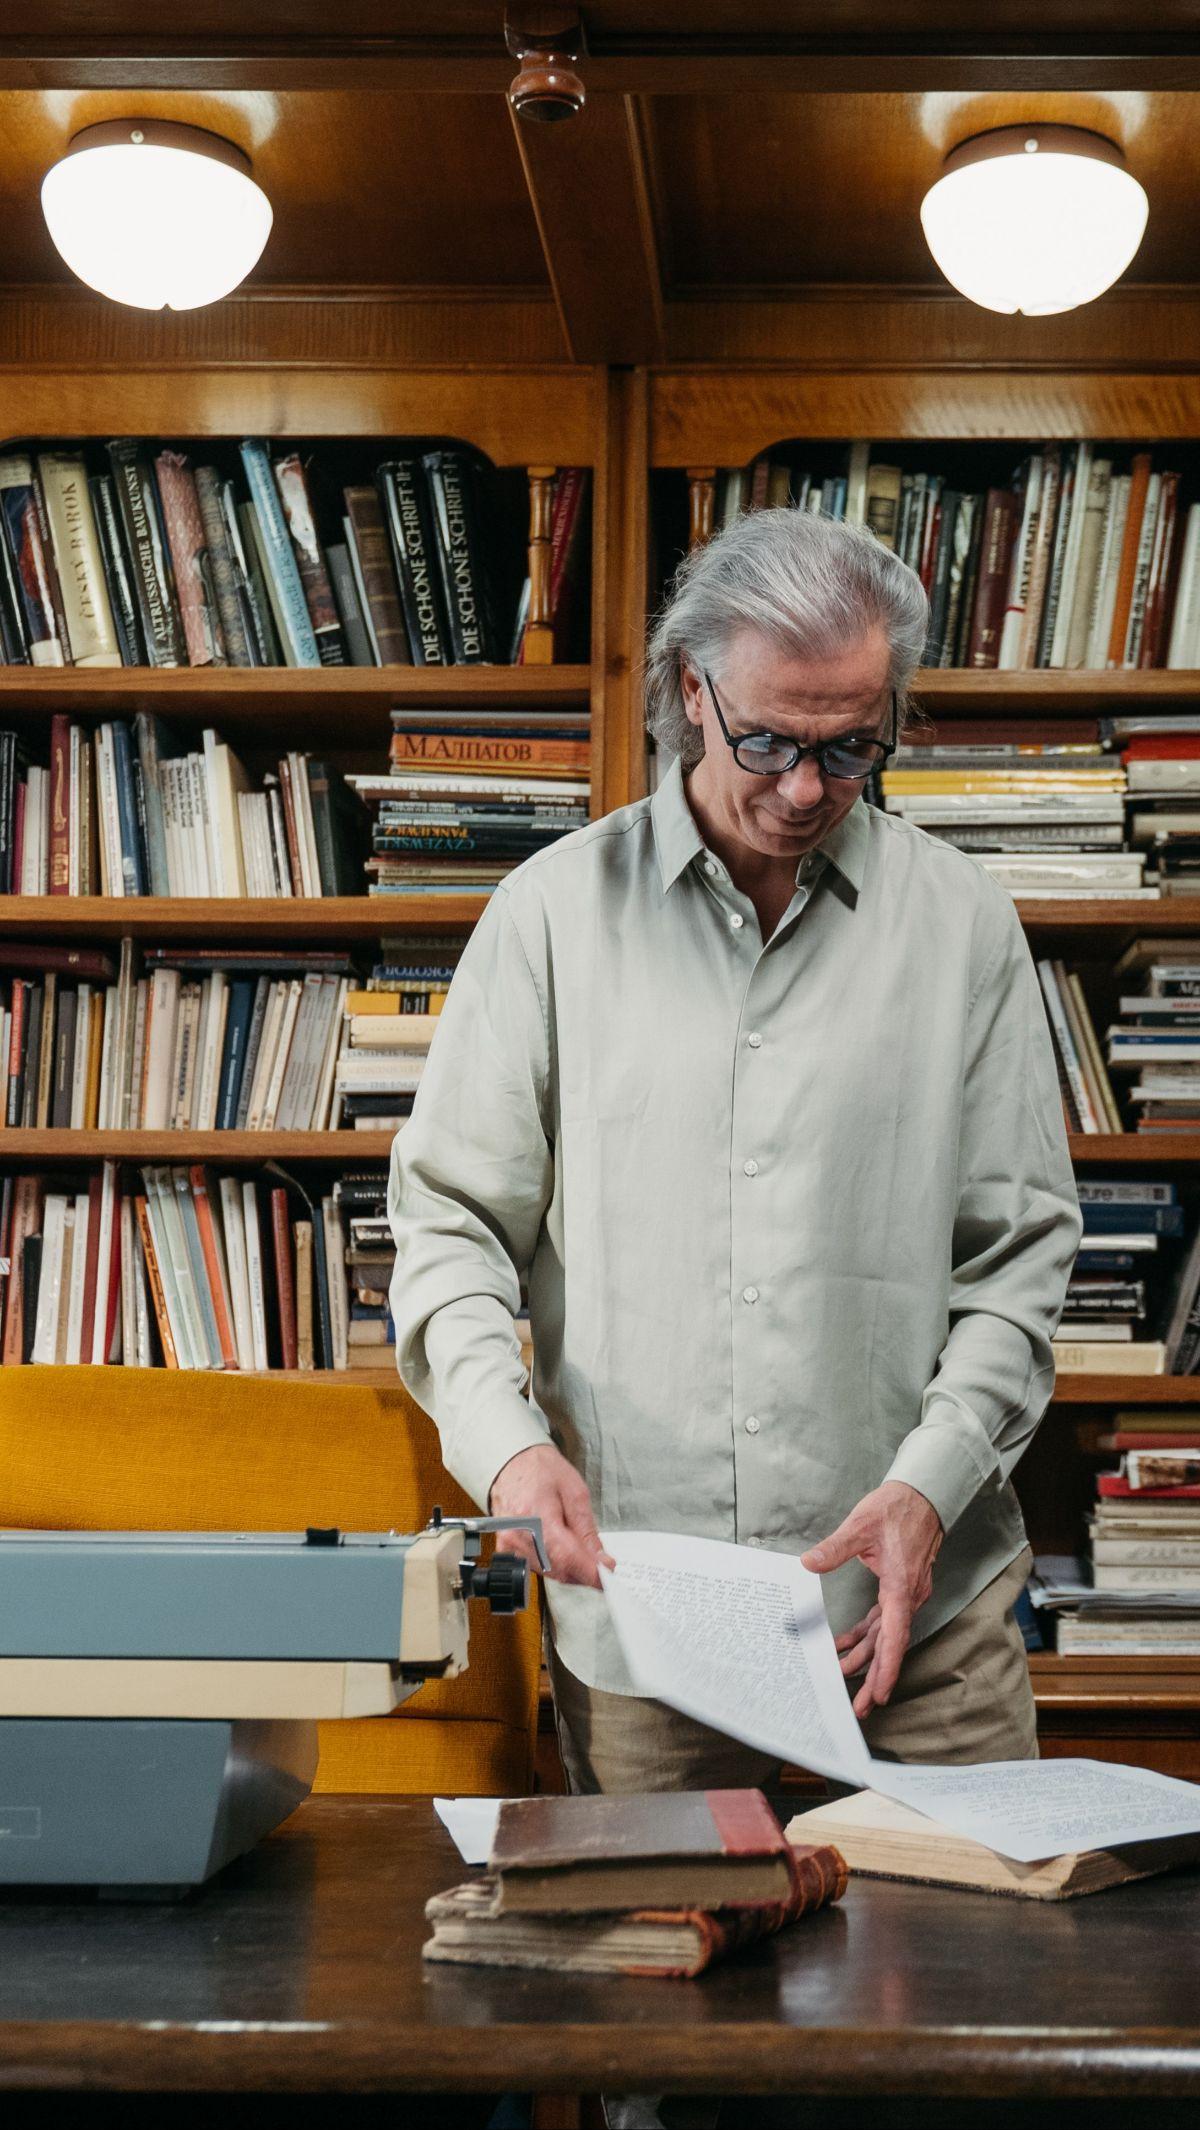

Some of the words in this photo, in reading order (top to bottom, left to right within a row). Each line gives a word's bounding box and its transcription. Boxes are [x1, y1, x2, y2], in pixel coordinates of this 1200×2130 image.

[62, 481, 83, 549] BAROK
[123, 464, 147, 538] BAUKUNST
[138, 541, 166, 642] ALTRUSSISCHE
[422, 634, 441, 662] DIE
[463, 627, 481, 655] DIE
